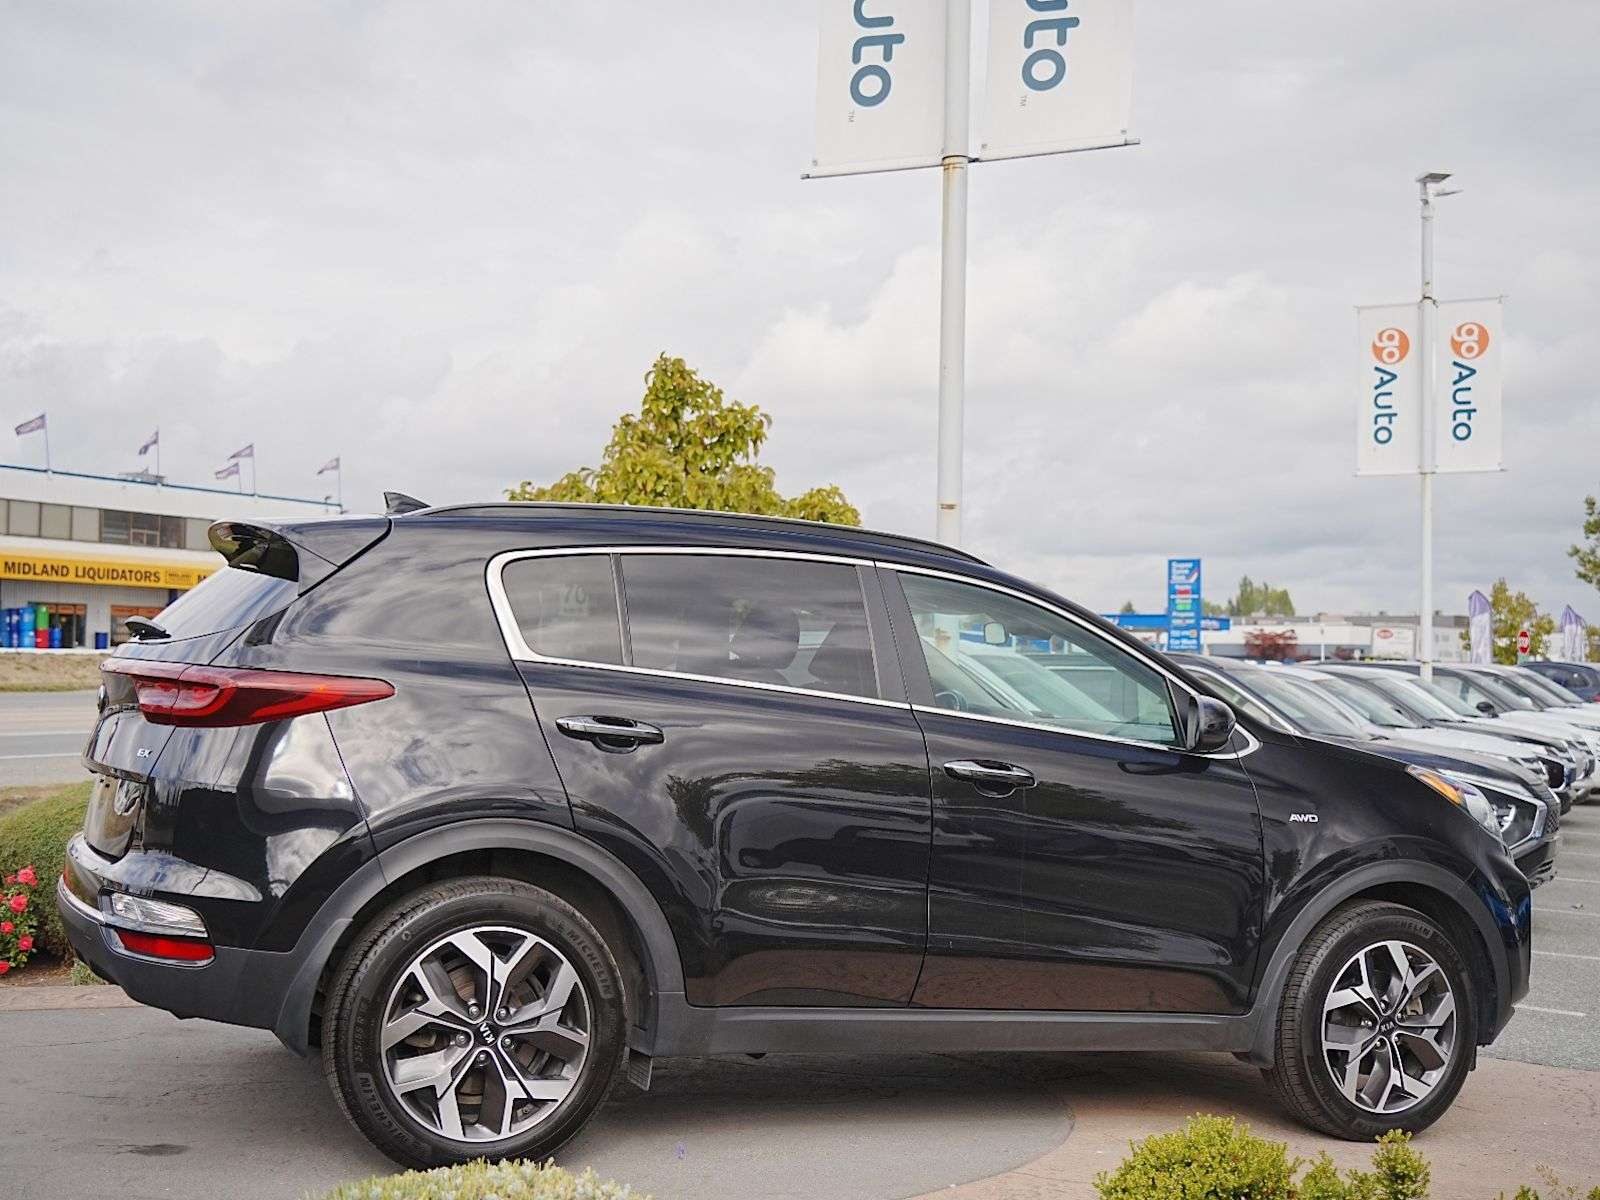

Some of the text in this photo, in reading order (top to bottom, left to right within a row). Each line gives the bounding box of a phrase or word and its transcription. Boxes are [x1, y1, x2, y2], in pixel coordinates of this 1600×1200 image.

[1374, 366, 1398, 444] Auto
[1452, 361, 1477, 441] Auto
[4, 561, 70, 577] MIDLAND
[75, 566, 161, 583] LIQUIDATORS
[137, 748, 151, 758] EX
[1289, 813, 1319, 823] AWD
[565, 928, 614, 995] MICHELIN
[480, 1022, 495, 1044] KIA
[1380, 1021, 1395, 1033] KIA
